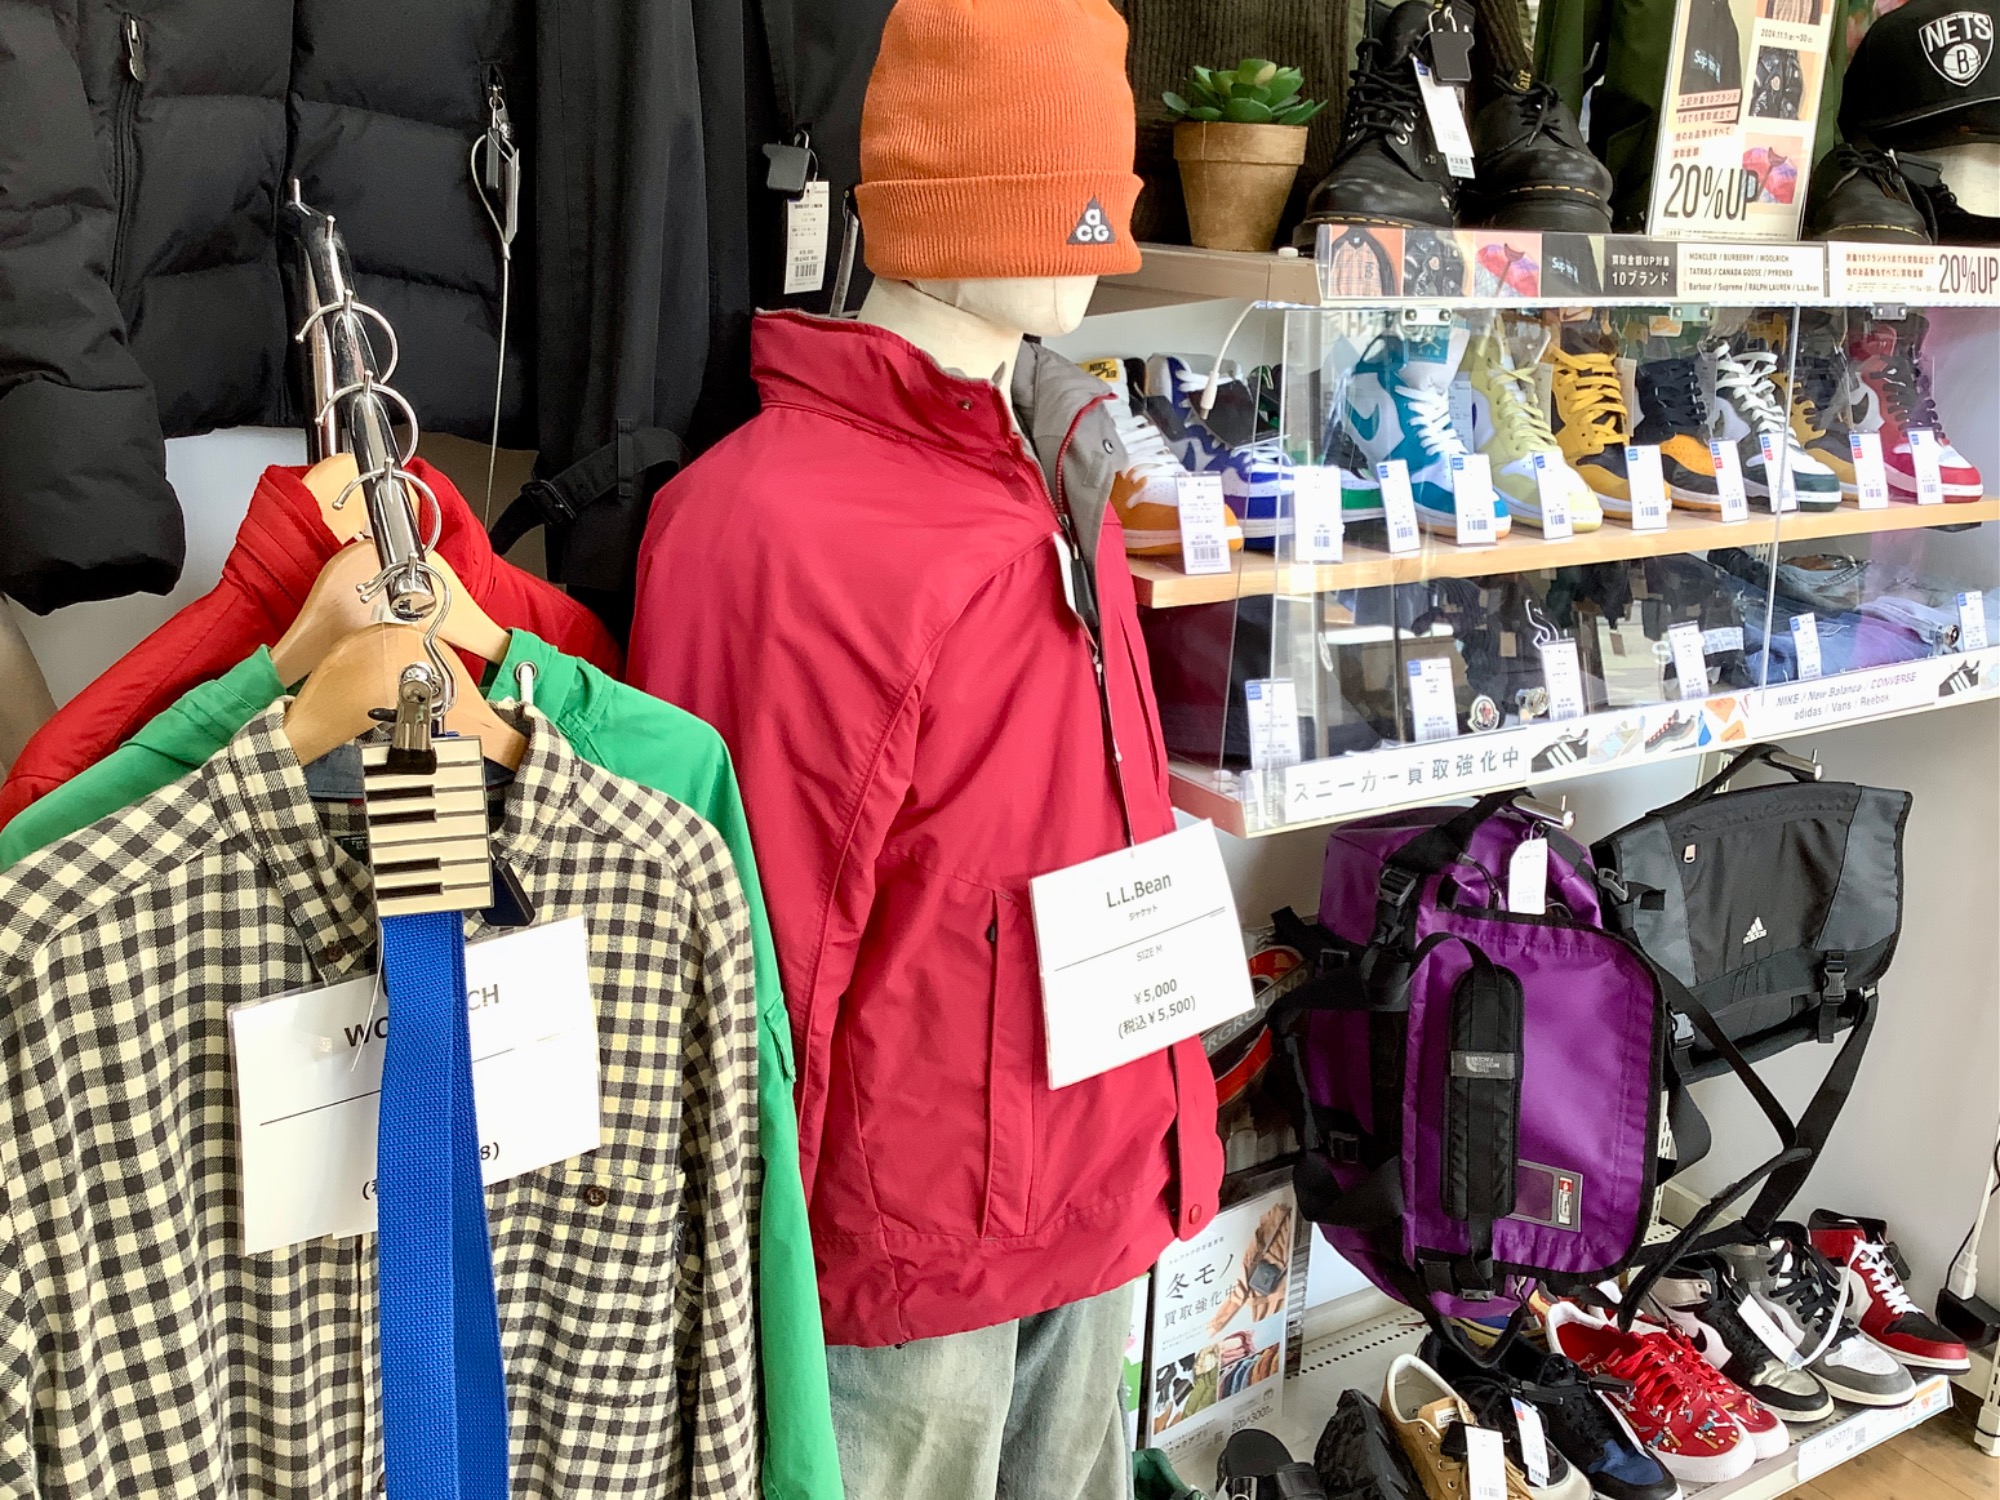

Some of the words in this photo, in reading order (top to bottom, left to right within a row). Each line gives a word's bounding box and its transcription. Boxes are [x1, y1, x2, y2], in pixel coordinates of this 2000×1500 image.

[1925, 14, 1991, 53] NETS
[1956, 49, 1970, 74] B
[1663, 163, 1760, 221] 20%UP
[1612, 254, 1671, 267] 買取金額UP対象
[1689, 253, 1717, 261] MONCLER
[1723, 254, 1754, 262] BURBERRY
[1612, 271, 1670, 287] 10ブランド
[1689, 268, 1713, 276] TATRAS
[1718, 268, 1742, 276] CANADA
[1743, 269, 1762, 277] GOOSE
[1939, 253, 1999, 294] 20%UP
[1689, 282, 1712, 291] Barbour
[1718, 283, 1743, 292] Supreme
[1748, 283, 1767, 291] RALPH
[1768, 283, 1791, 291] LAUREN
[1776, 693, 1800, 707] NIKE
[1807, 688, 1826, 701] New
[1828, 683, 1862, 697] Balance
[1870, 671, 1917, 690] CONVERSE
[1794, 705, 1822, 720] adidas
[1831, 701, 1852, 713] Vans
[1860, 693, 1889, 707] Reebok
[1106, 874, 1172, 908] L.L.Bean
[1136, 947, 1154, 961] SIZE
[1155, 945, 1163, 954] M
[1133, 978, 1177, 1005] ¥5,000
[1118, 995, 1196, 1039] (税込¥5,500)
[1166, 1254, 1234, 1300] 冬モノ
[1164, 1284, 1237, 1329] 買取強化中
